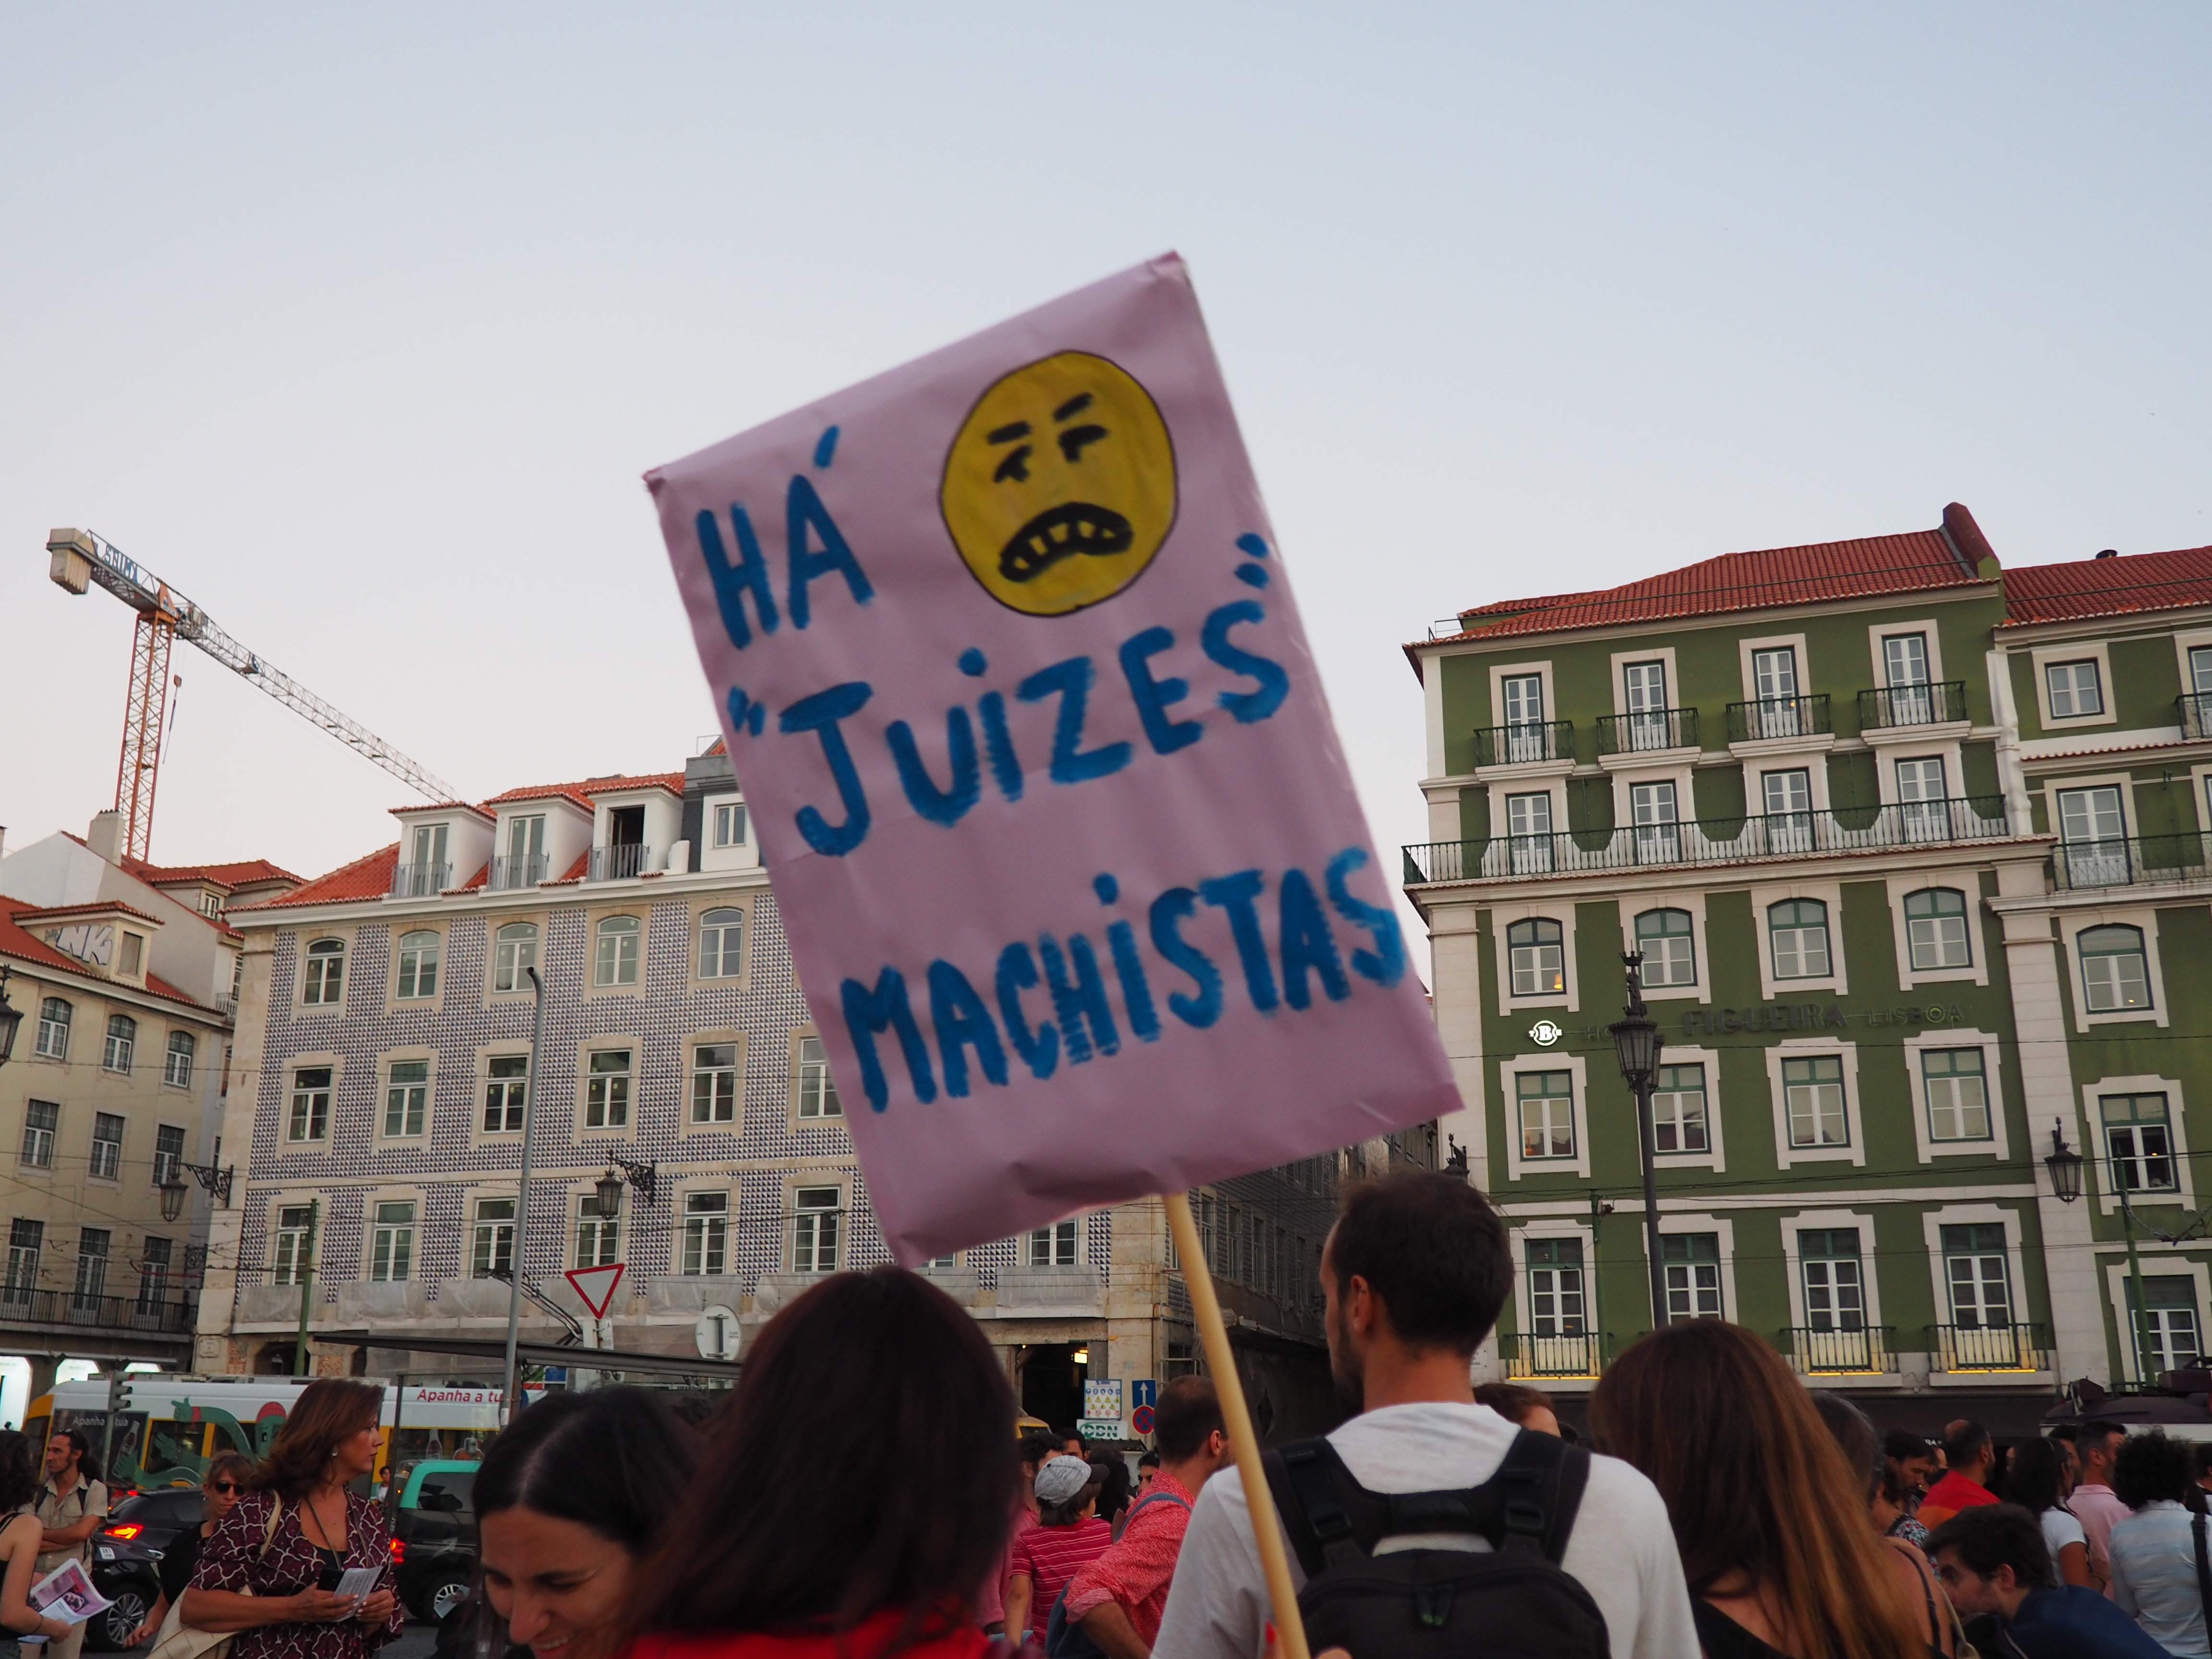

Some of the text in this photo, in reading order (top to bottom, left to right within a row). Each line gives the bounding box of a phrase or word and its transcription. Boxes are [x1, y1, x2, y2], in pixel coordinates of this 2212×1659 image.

[695, 424, 875, 650] HÁ
[1684, 1002, 1848, 1036] FIGUEIRA
[1868, 1003, 1964, 1027] LISBOA
[417, 1388, 504, 1403] Apanha a tu
[72, 1416, 129, 1427] Apanha tua
